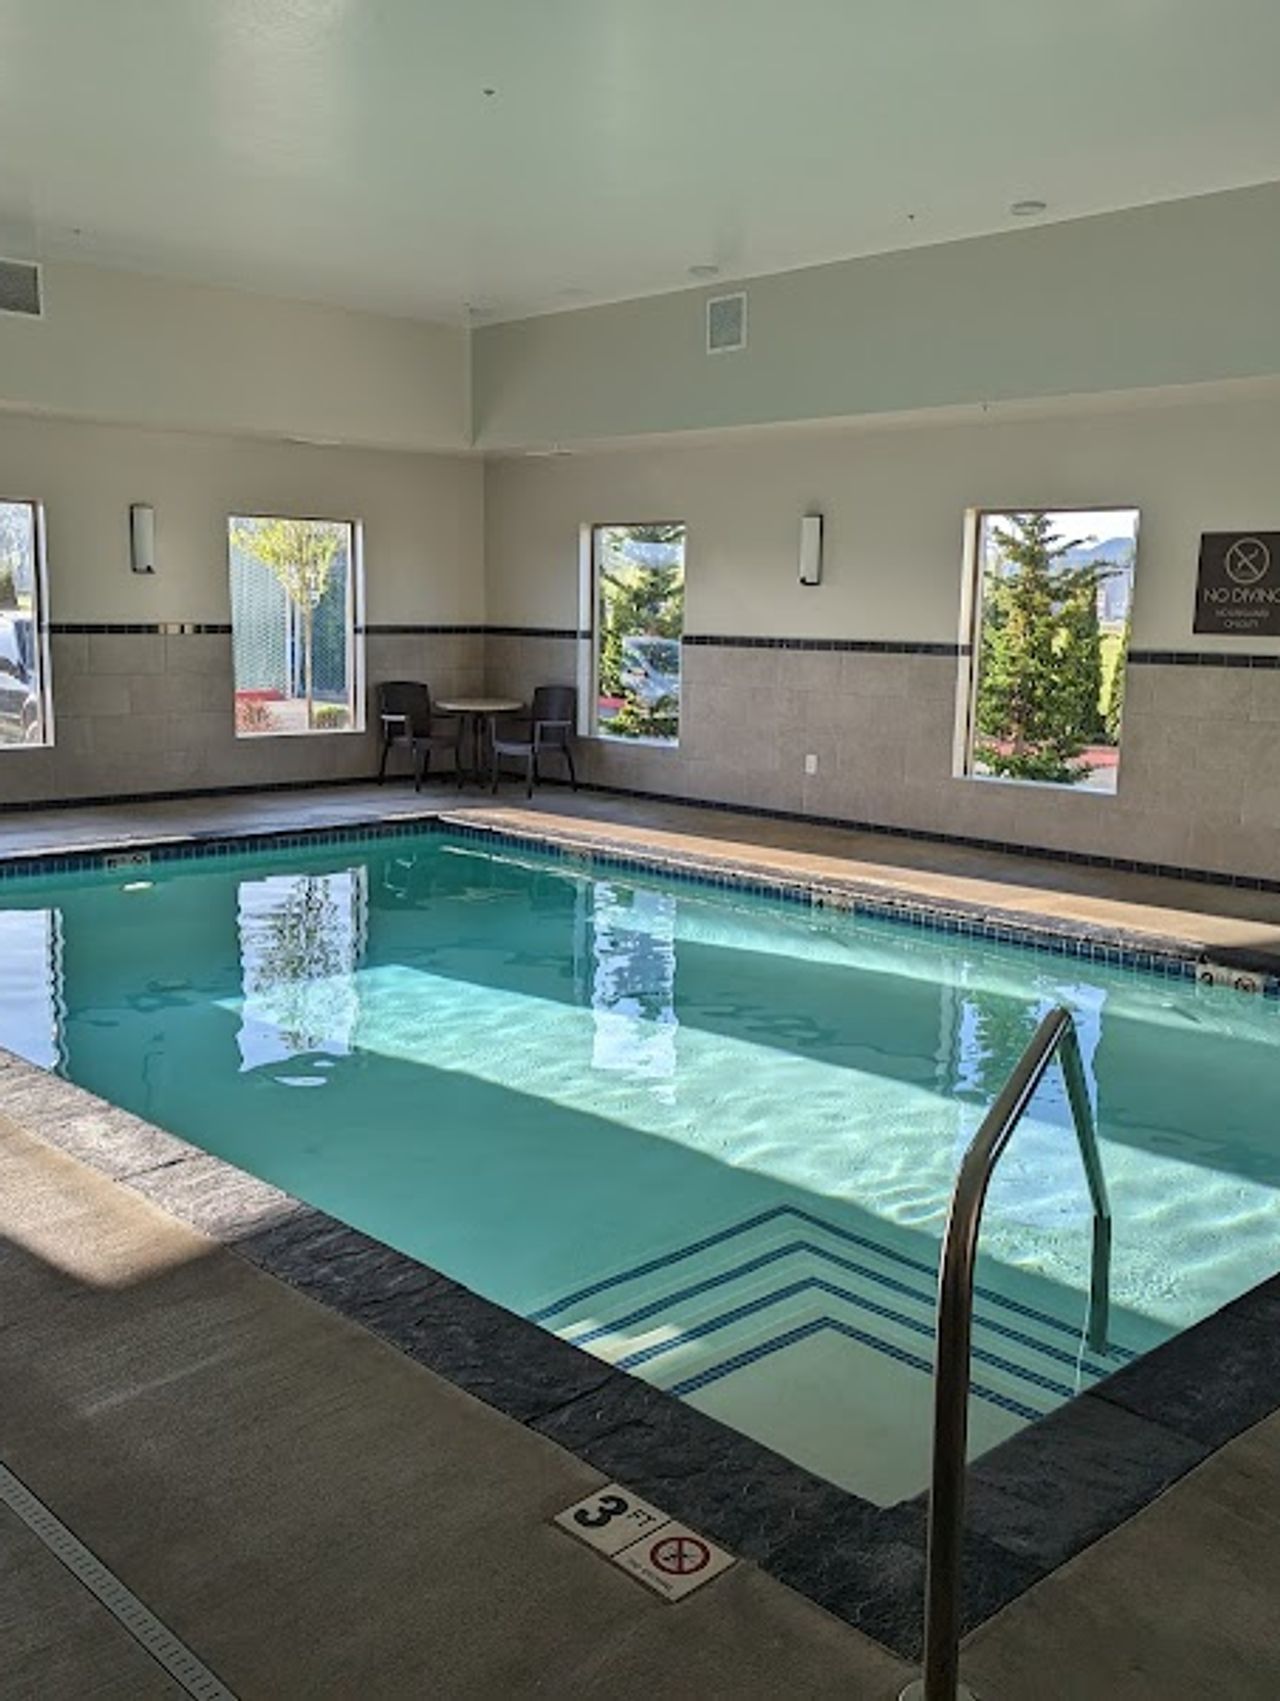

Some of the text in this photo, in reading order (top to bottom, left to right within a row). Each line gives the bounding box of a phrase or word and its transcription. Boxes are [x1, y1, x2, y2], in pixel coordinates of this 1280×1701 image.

[1203, 587, 1230, 603] NO
[573, 1495, 657, 1528] 3 FT
